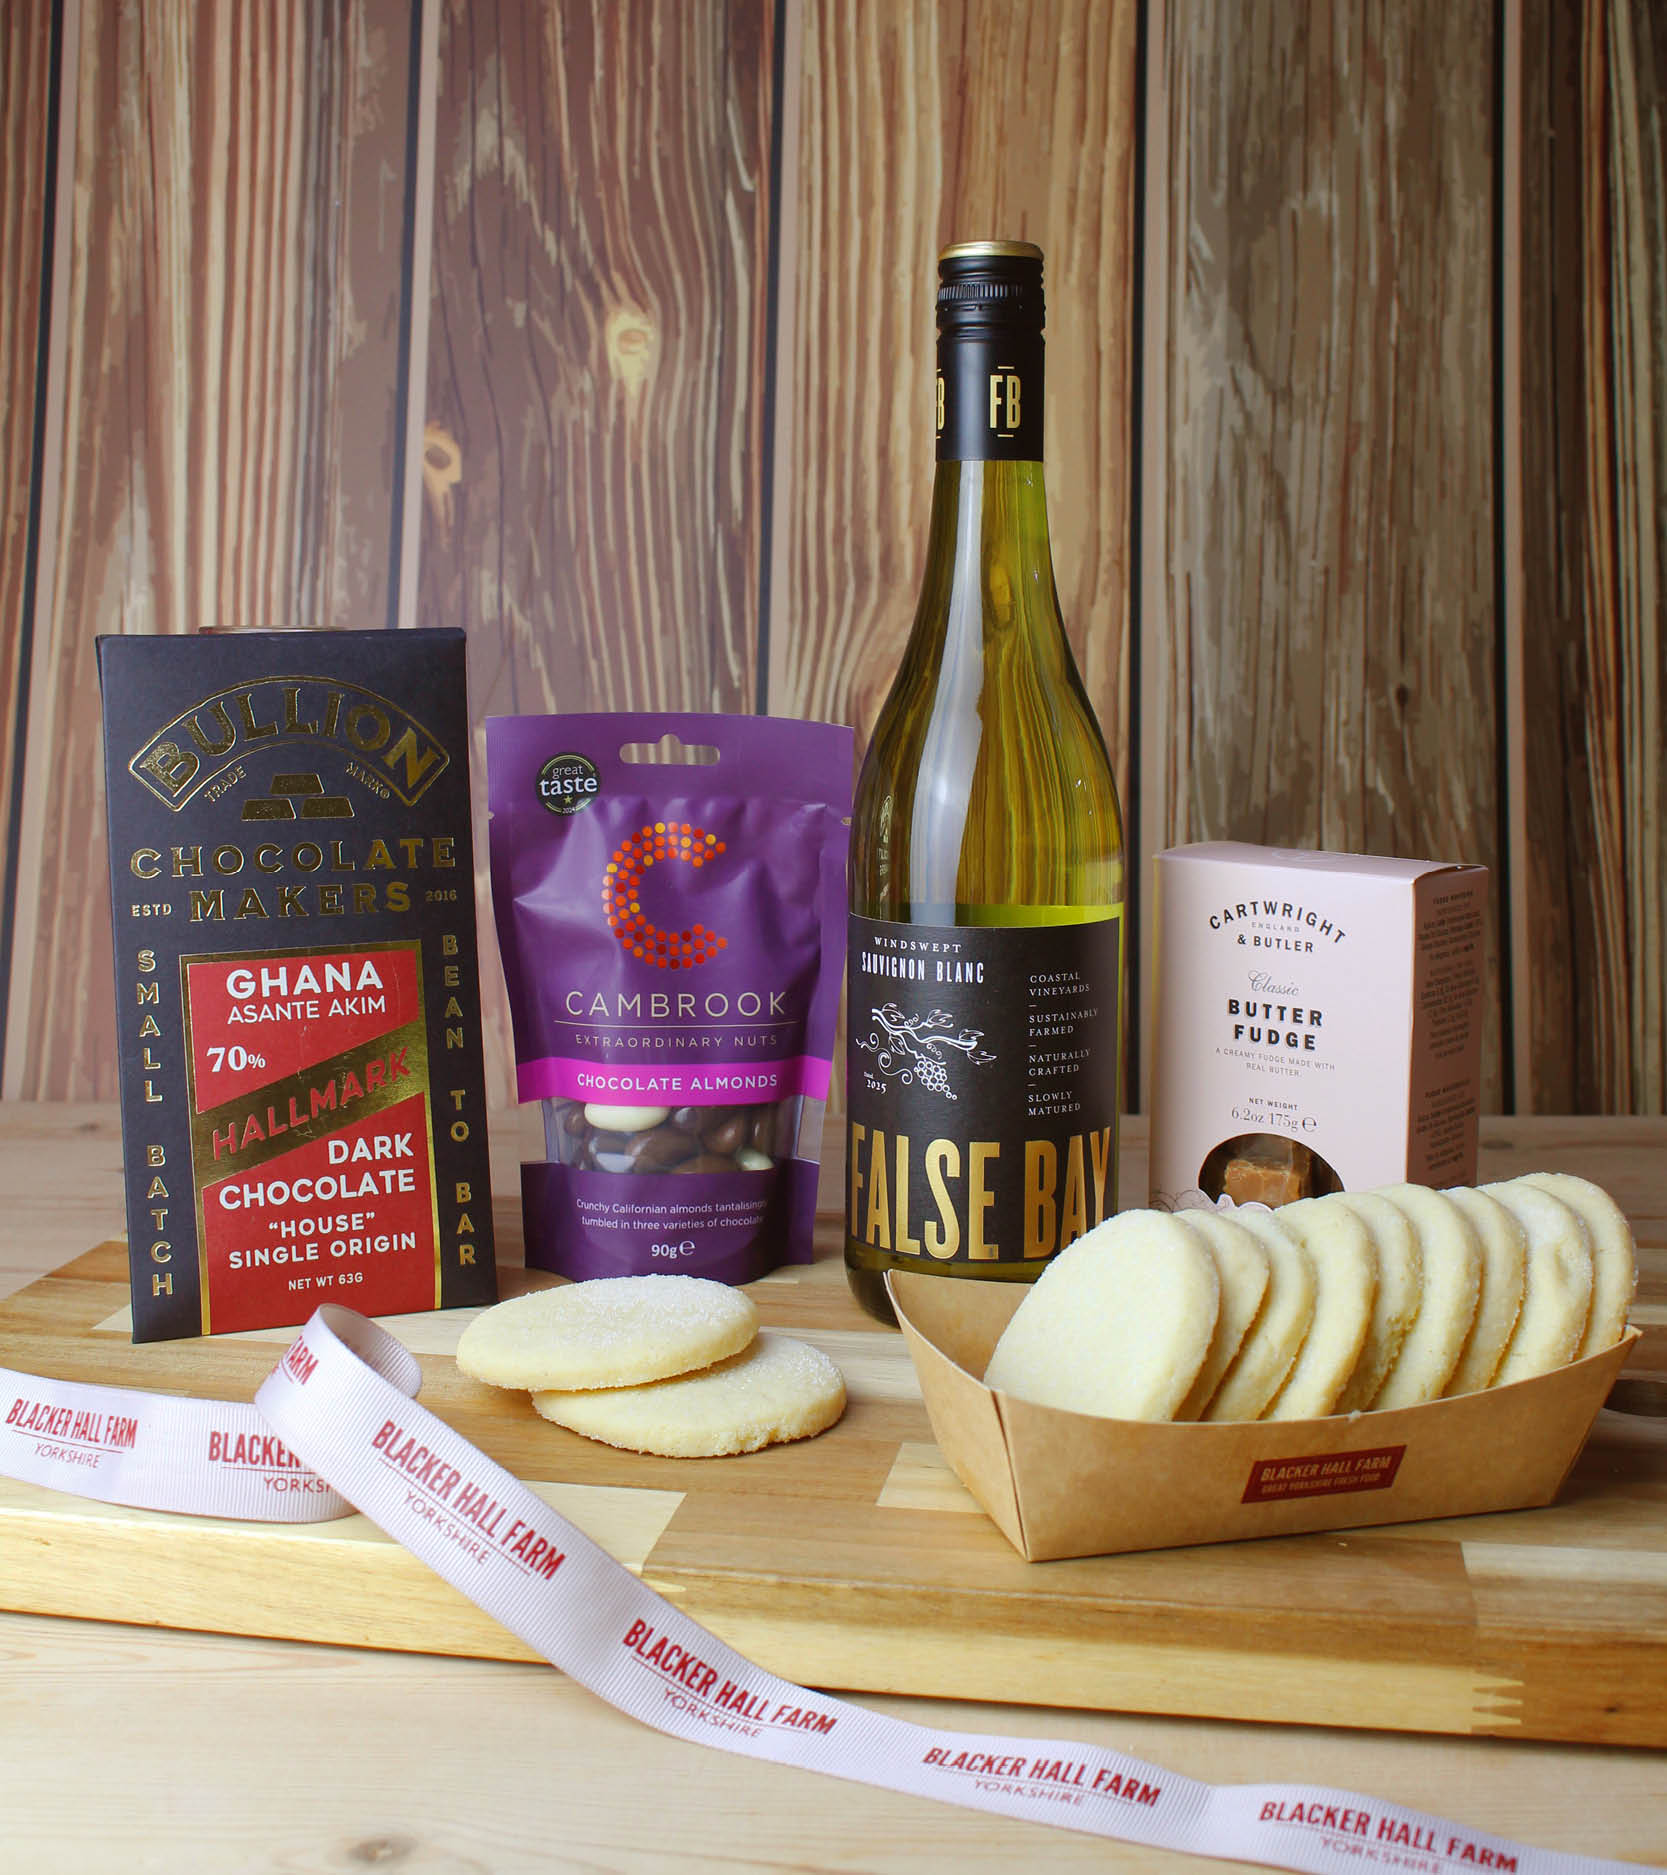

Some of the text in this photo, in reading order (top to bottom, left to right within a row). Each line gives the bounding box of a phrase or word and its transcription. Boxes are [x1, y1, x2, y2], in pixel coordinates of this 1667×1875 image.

[989, 374, 1021, 429] FB
[140, 687, 440, 798] BULLION
[205, 765, 247, 802] TRADE
[552, 765, 583, 779] great
[539, 776, 598, 796] taste
[130, 837, 456, 879] CHOCOLATE
[189, 881, 411, 922] MAKERS
[425, 889, 457, 902] 2016
[131, 904, 173, 917] ESTD
[1209, 900, 1346, 944] CARTWRIGHT
[1251, 922, 1300, 933] ENGLAND
[874, 936, 963, 953] WINDSWEPT
[1237, 934, 1313, 953] & BUTLER
[226, 960, 383, 999] GHANA
[861, 951, 984, 984] SAUVIGNON BLANC
[1030, 972, 1080, 984] COASTAL
[1029, 984, 1090, 997] VINEYARDS
[1248, 970, 1299, 996] Classic
[227, 996, 386, 1025] ASANTE AKIM
[565, 991, 786, 1018] CAMBROOK
[1028, 1008, 1099, 1024] SUSTAINABLY
[1228, 998, 1322, 1026] BUTTER
[575, 1034, 777, 1048] EXTRAORDINARY NUTS
[1029, 1025, 1074, 1037] FARMED
[1234, 1024, 1316, 1051] FUDGE
[206, 1046, 265, 1073] 70%
[1028, 1048, 1091, 1063] NATURALLY
[1223, 1048, 1255, 1059] CREAMY
[1258, 1053, 1285, 1064] FUDGE
[1289, 1058, 1311, 1068] MADE
[1314, 1062, 1335, 1071] WITH
[1246, 1062, 1265, 1072] REAL
[577, 1073, 777, 1091] CHOCOLATE ALMONDS
[1028, 1063, 1079, 1077] CRAFTED
[442, 934, 476, 1266] BEAN TO BAR
[867, 1079, 887, 1094] 2025
[1028, 1091, 1073, 1103] SLOWLY
[212, 1046, 411, 1160] HALLMARK
[1028, 1103, 1081, 1116] MATURED
[1248, 1097, 1298, 1111] NET WEIGHT
[137, 950, 173, 1297] SMALL BATCH
[1231, 1107, 1264, 1123] 6.2oz
[1269, 1112, 1298, 1133] 175g
[328, 1132, 414, 1165] DARK
[219, 1168, 416, 1210] CHOCOLATE
[852, 1121, 1111, 1260] FALSE BAY
[577, 1199, 609, 1213] Crunchy
[612, 1204, 667, 1213] Californian
[670, 1203, 712, 1213] almonds
[582, 1216, 618, 1229] tumbled
[621, 1219, 630, 1229] in
[633, 1220, 660, 1230] three
[663, 1219, 704, 1230] varieties
[707, 1218, 717, 1227] of
[229, 1232, 416, 1270] SINGLE ORIGIN
[288, 1272, 363, 1291] NET WT 63G
[5, 1398, 138, 1448] BLACKER HALL FARM
[35, 1442, 100, 1468] YORKSHIRE
[1261, 1456, 1392, 1482] BLACKER HALL FARM
[371, 1420, 567, 1580] BLACKER HALL FARM
[404, 1490, 491, 1566] YORKSHIRE
[622, 1618, 838, 1735] BLACKER HALL FARM
[662, 1687, 763, 1739] YORKSHIRE
[923, 1747, 1161, 1808] BLACKER HALL FARM
[975, 1779, 1086, 1806] YORKSHIRE
[1258, 1801, 1519, 1873] BLACKER HALL FARM
[1319, 1836, 1442, 1875] YORKSHIRE
